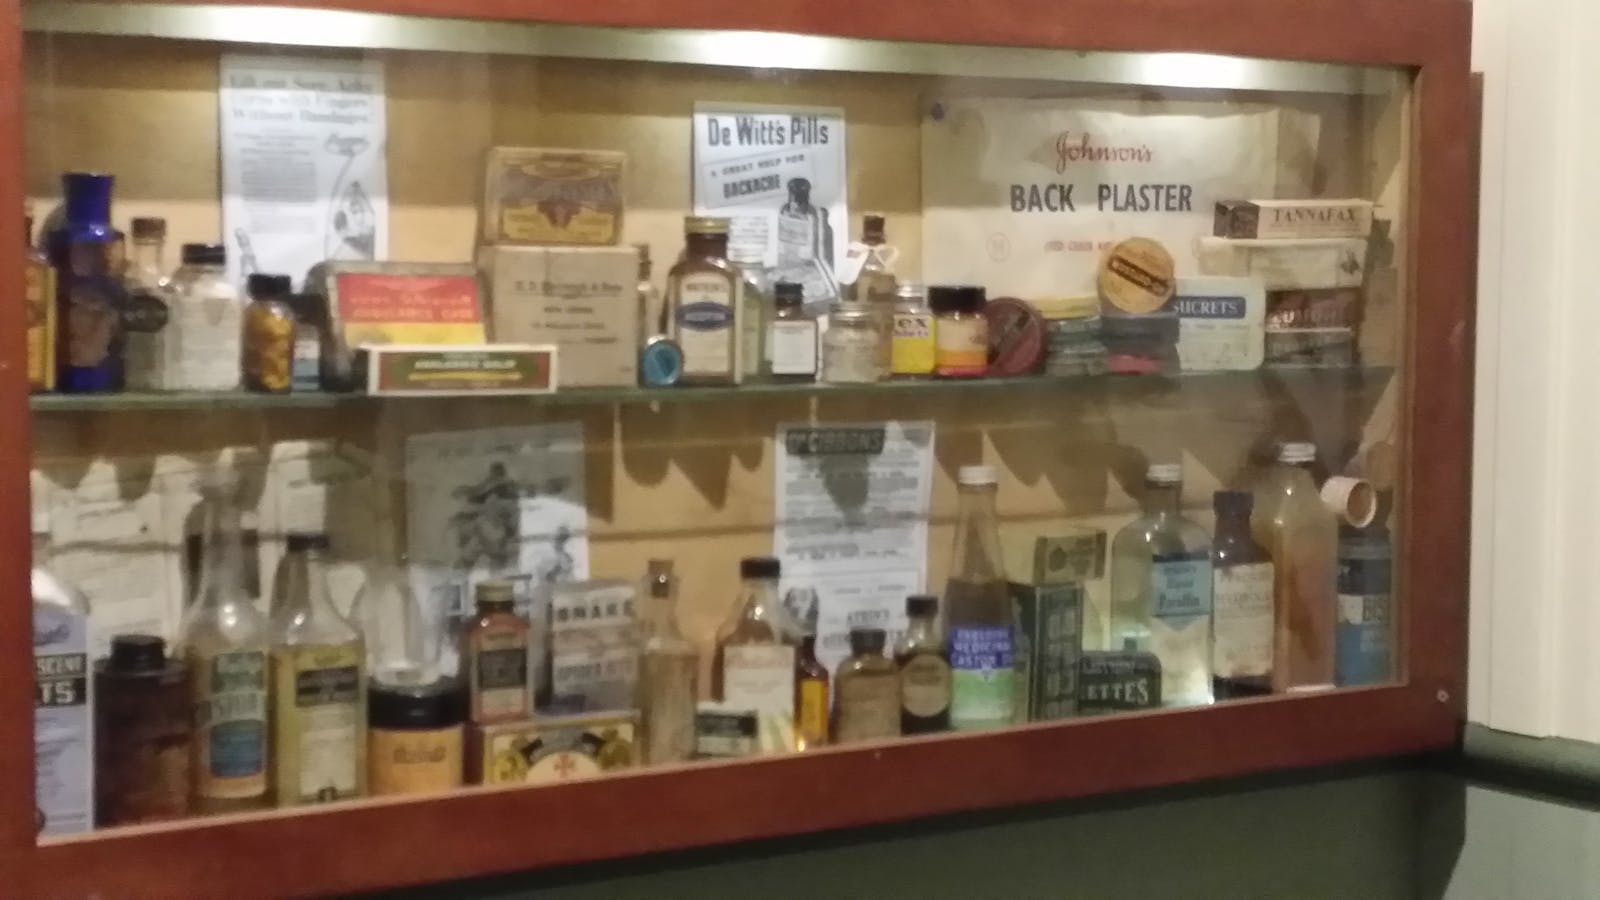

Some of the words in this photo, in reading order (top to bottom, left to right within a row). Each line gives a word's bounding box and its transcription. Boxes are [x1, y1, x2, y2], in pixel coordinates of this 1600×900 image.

[708, 118, 731, 146] De
[736, 115, 785, 146] Witt's
[790, 115, 829, 145] Pills
[1056, 130, 1153, 174] Johnson's
[723, 174, 780, 199] BACKACHE
[1010, 183, 1075, 212] BACK
[1098, 183, 1193, 212] PLASTER
[1273, 206, 1358, 223] TANNAFAX
